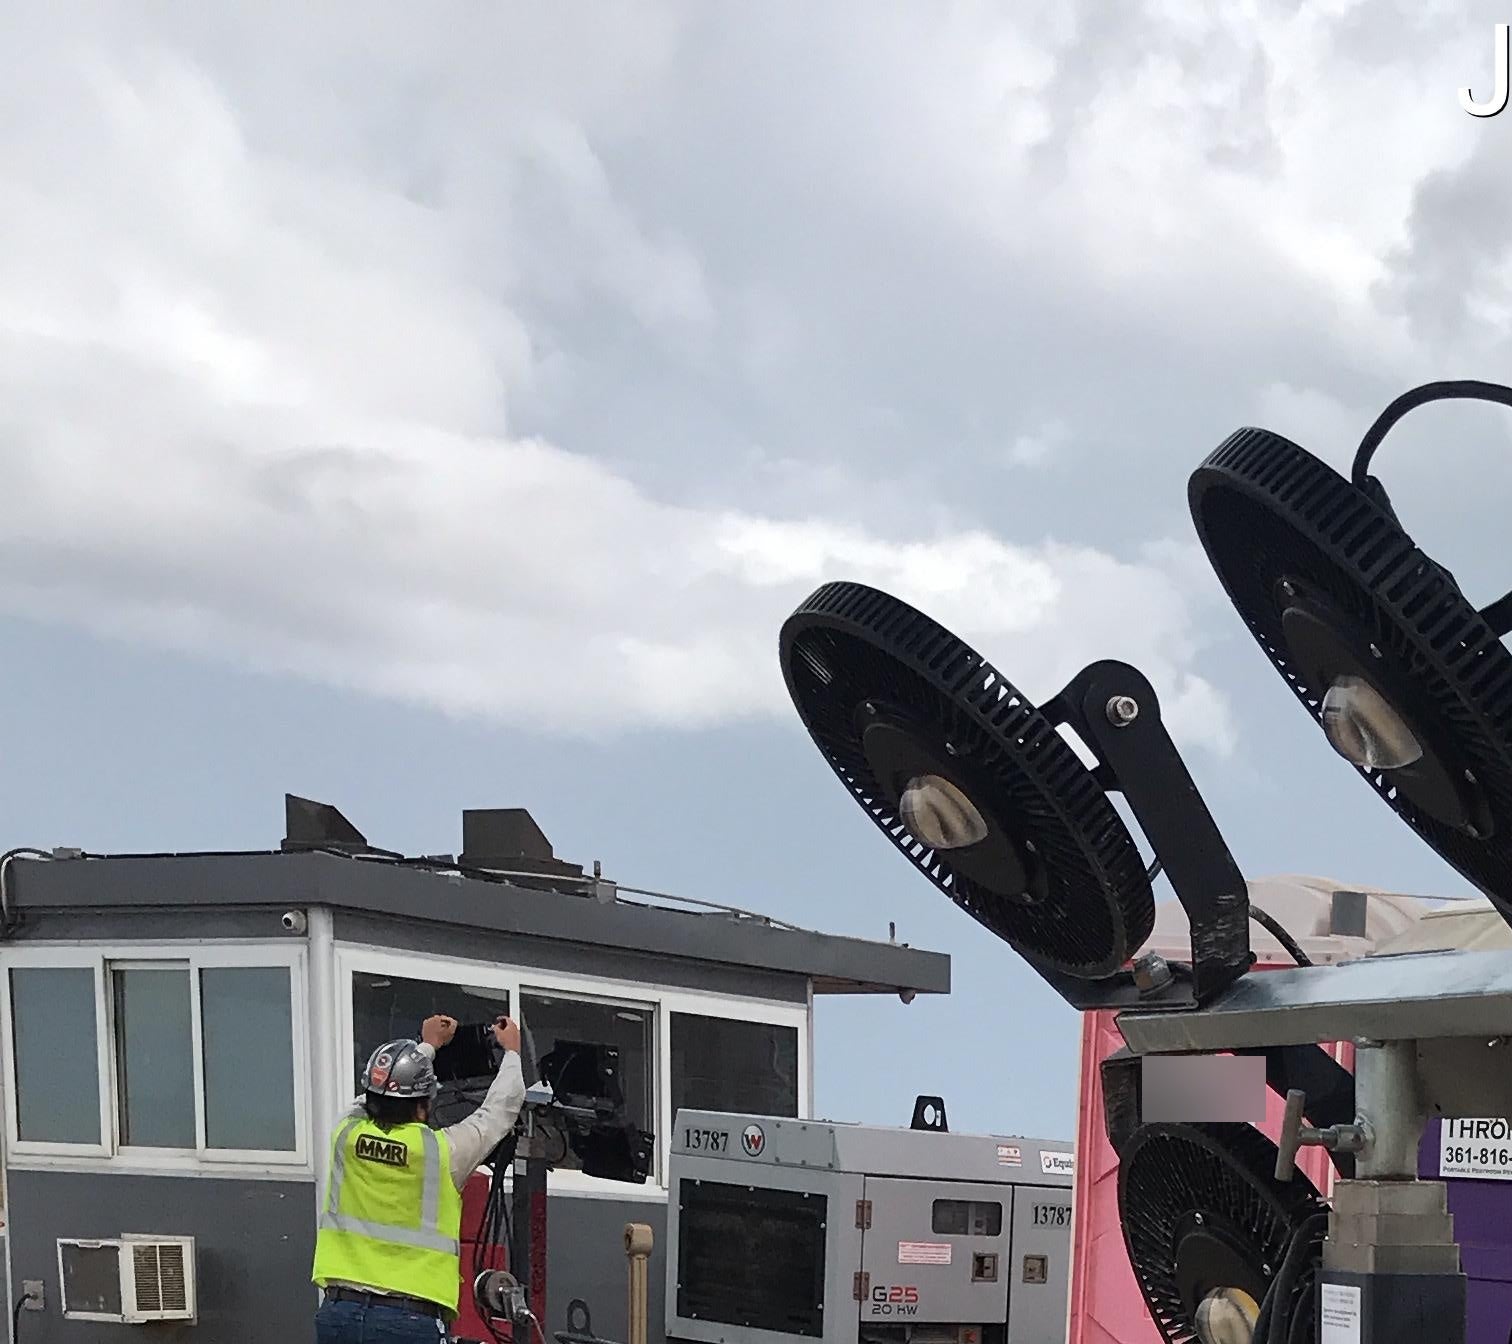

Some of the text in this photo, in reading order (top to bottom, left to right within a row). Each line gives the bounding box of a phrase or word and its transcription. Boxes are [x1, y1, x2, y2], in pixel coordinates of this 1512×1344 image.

[360, 1138, 404, 1163] MMR
[685, 1128, 729, 1152] 13787
[1033, 1205, 1072, 1226] 13787
[872, 1285, 919, 1303] G25
[872, 1304, 892, 1315] 20
